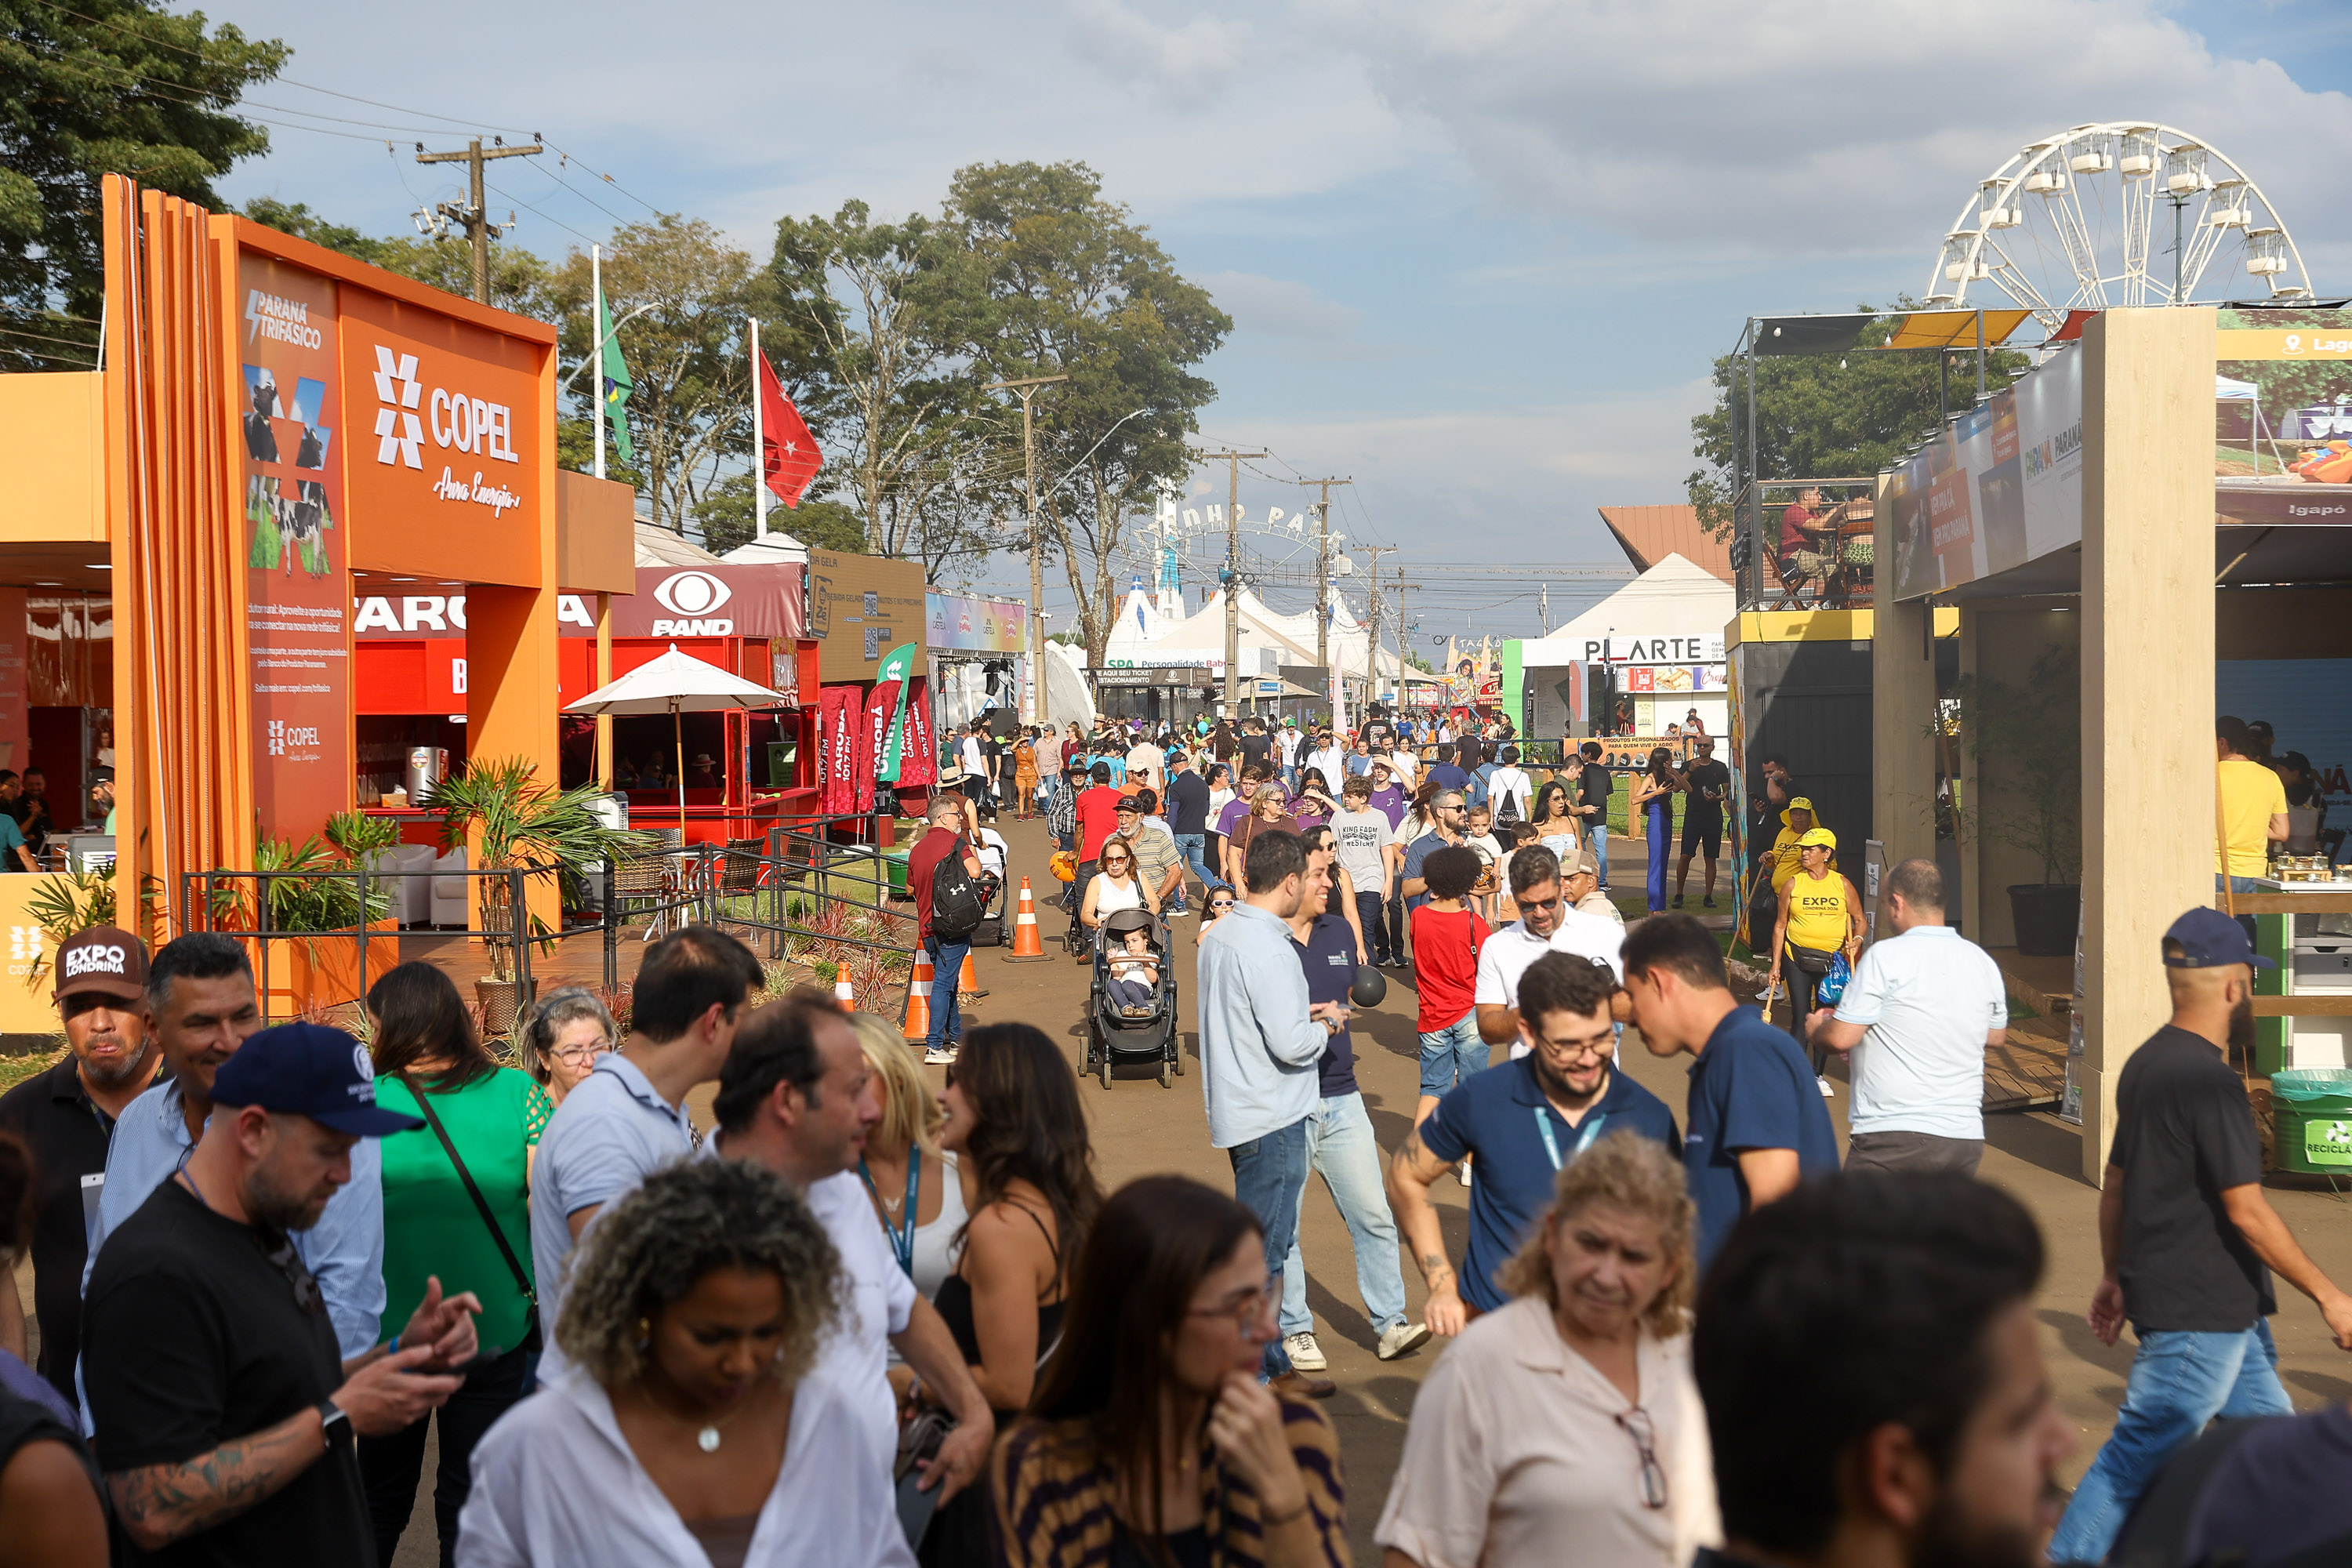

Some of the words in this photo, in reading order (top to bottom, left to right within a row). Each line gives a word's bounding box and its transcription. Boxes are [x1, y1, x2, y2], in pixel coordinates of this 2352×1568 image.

[257, 292, 308, 325] PARANÁ
[261, 315, 321, 350] TRIFÁSICO
[431, 387, 519, 463] COPEL
[2055, 418, 2082, 459] PARANÁ
[2026, 435, 2053, 481] PARANÁ
[471, 471, 521, 519] Energia
[1930, 495, 1939, 517] VEM
[2288, 504, 2347, 517] Igapó
[1933, 527, 1942, 546] VEM
[1951, 508, 1970, 541] PARANÁ
[279, 604, 305, 617] Aproveite
[309, 607, 343, 618] oportunidade
[816, 605, 827, 622] Zé
[263, 621, 287, 630] conectar
[652, 619, 734, 637] BAND
[1142, 660, 1205, 669] Personalidade
[287, 728, 321, 746] COPEL
[920, 721, 927, 735] FM
[822, 739, 829, 756] FM
[844, 735, 851, 753] FM
[871, 705, 884, 778] TAROBÁ
[906, 725, 915, 758] CANAL
[1802, 897, 1839, 906] EXPO
[66, 944, 125, 968] EXPO
[66, 960, 125, 978] LONDRINA
